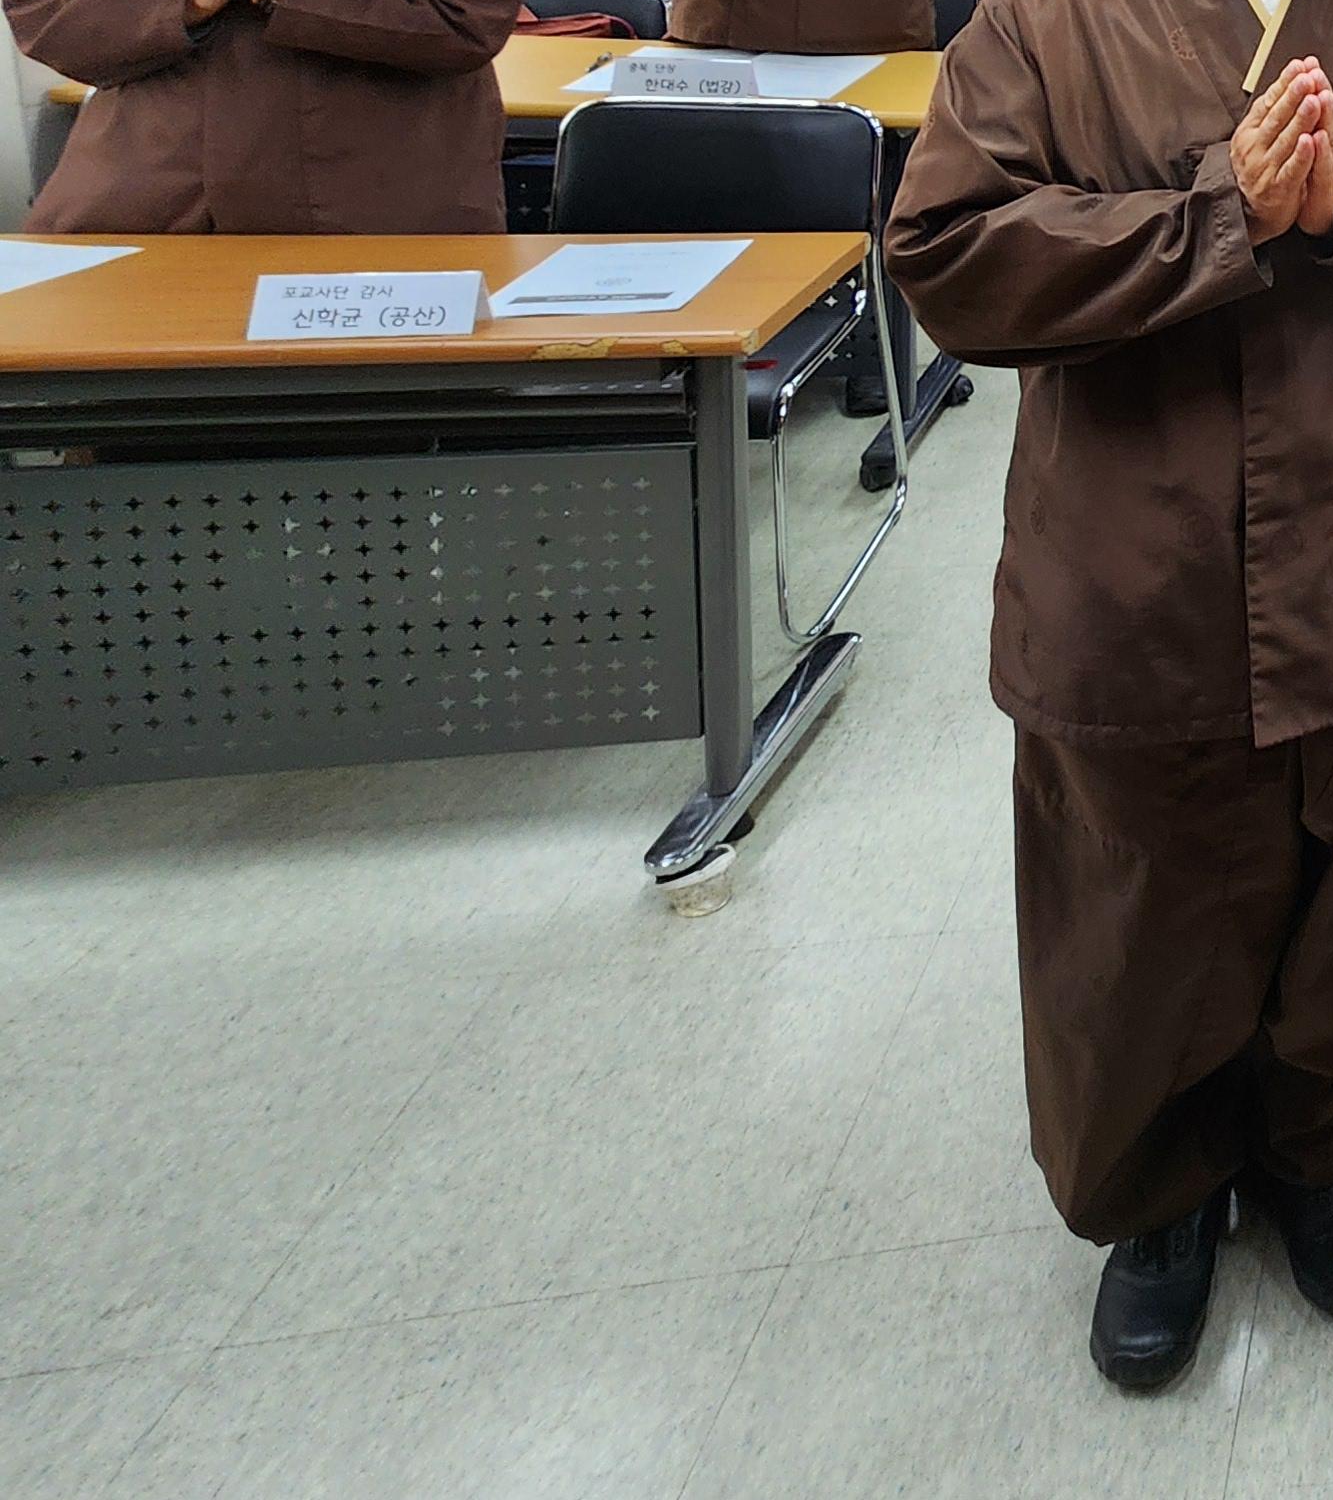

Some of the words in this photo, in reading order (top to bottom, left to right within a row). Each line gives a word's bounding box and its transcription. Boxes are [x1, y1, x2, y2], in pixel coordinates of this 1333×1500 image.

[281, 285, 349, 300] 포교사단
[360, 285, 393, 299] 감사
[292, 307, 362, 328] 신학균
[378, 305, 447, 327] (공산)
